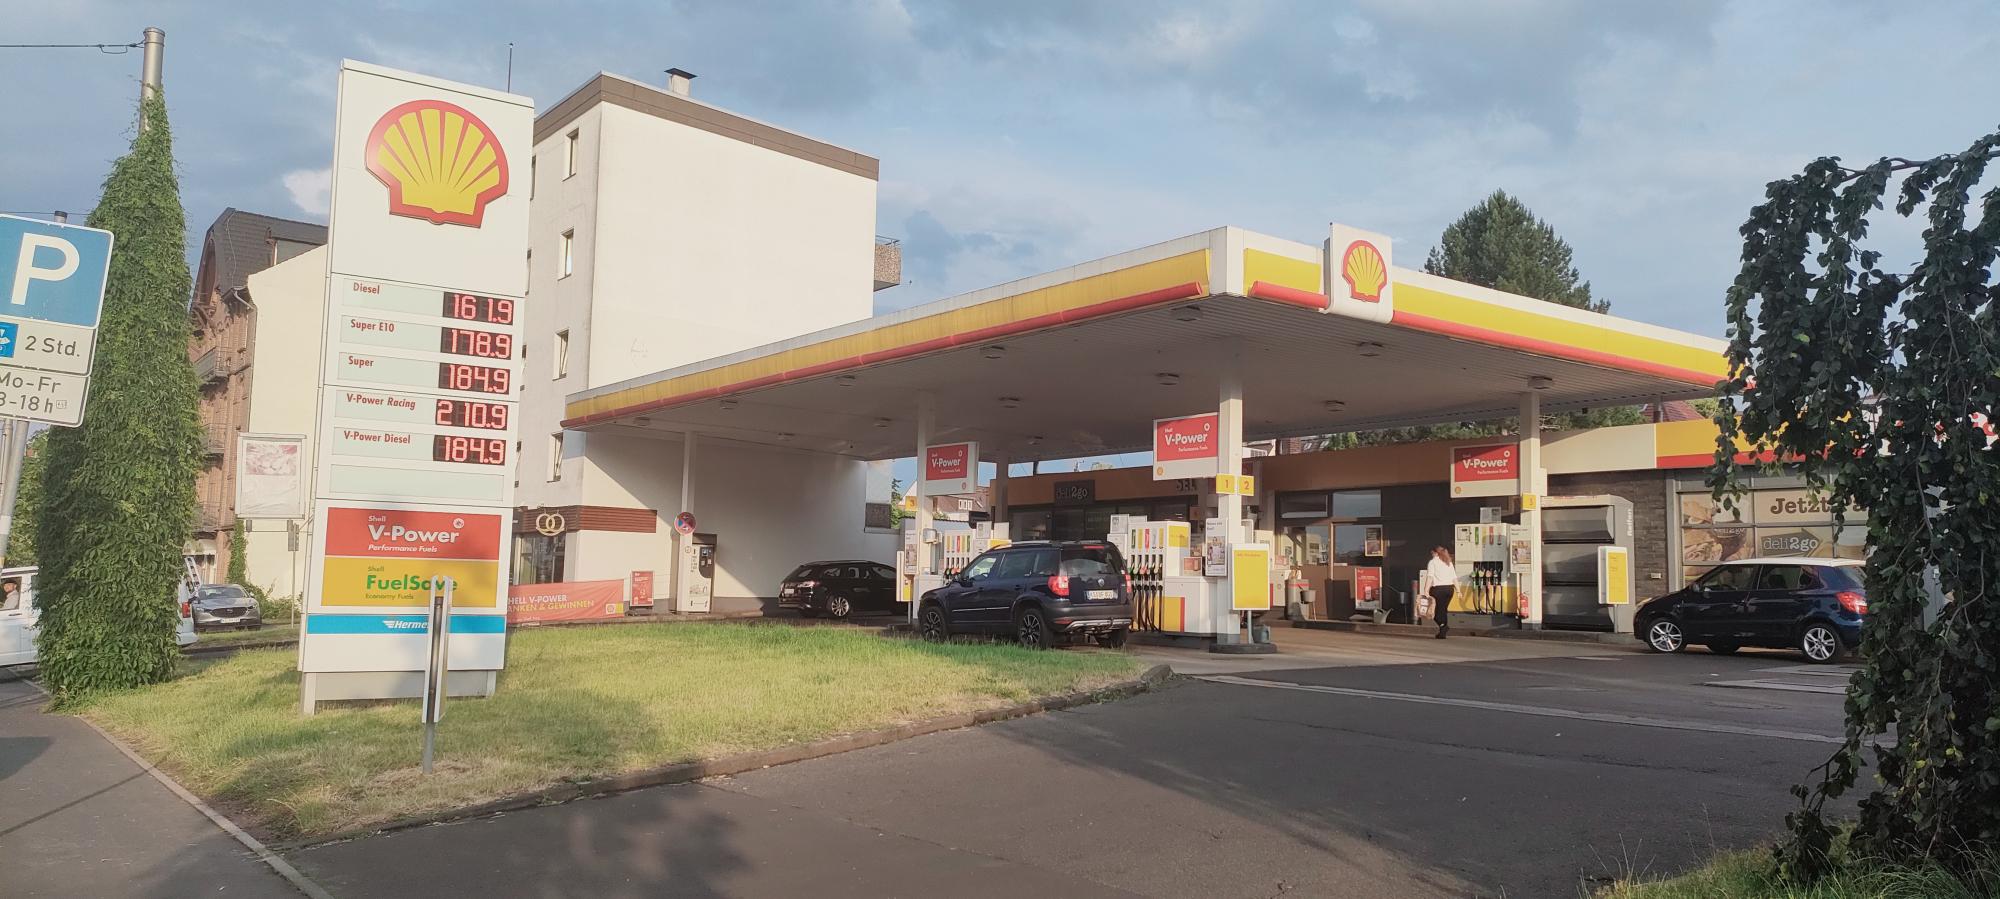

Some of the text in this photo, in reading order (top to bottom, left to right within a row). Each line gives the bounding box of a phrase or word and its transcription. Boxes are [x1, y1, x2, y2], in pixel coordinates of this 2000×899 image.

[11, 232, 80, 305] P
[353, 282, 380, 294] Diesel
[454, 293, 513, 324] 161.9
[350, 318, 394, 332] Super E10
[25, 335, 80, 357] 2 Std.
[451, 329, 511, 359] 178.9
[348, 355, 374, 368] Super
[0, 371, 61, 393] Mo-Fr
[450, 364, 509, 393] 184.9
[44, 398, 53, 413] h
[347, 393, 416, 411] V-Power Racing
[437, 400, 507, 429] 210.9
[344, 430, 411, 444] V-Power Diesel
[1165, 433, 1208, 446] V-Power
[444, 436, 505, 464] 184.9
[931, 458, 961, 468] V-Power
[1463, 459, 1508, 469] V-Power
[1225, 479, 1229, 489] 1
[1243, 480, 1250, 490] 2
[1770, 497, 1830, 515] Jetzt
[368, 524, 460, 544] V-Power
[368, 544, 417, 552] Performance
[1763, 537, 1819, 552] deli2go
[508, 595, 567, 605] HELL V-POWER
[548, 600, 594, 610] GEWINNEN
[394, 620, 429, 630] Herme
